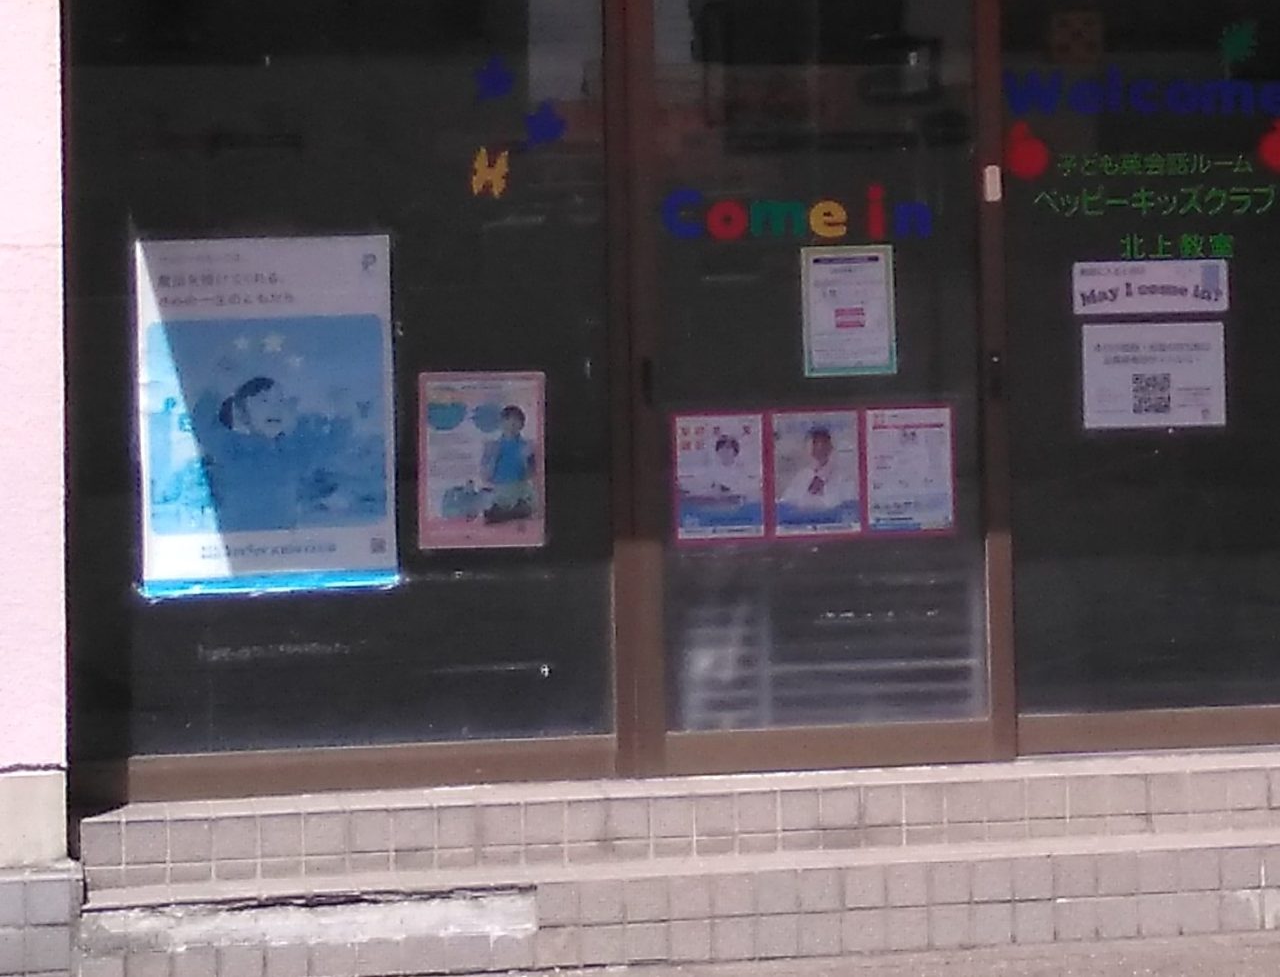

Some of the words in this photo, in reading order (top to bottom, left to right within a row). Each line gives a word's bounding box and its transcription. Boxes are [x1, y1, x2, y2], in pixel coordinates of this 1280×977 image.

[1057, 151, 1254, 177] 子ども英会話ルーム
[664, 190, 848, 240] Come
[865, 181, 934, 240] in
[1119, 232, 1235, 260] 北上教室
[1079, 284, 1119, 308] May
[1124, 281, 1133, 298] I
[1137, 283, 1189, 299] come
